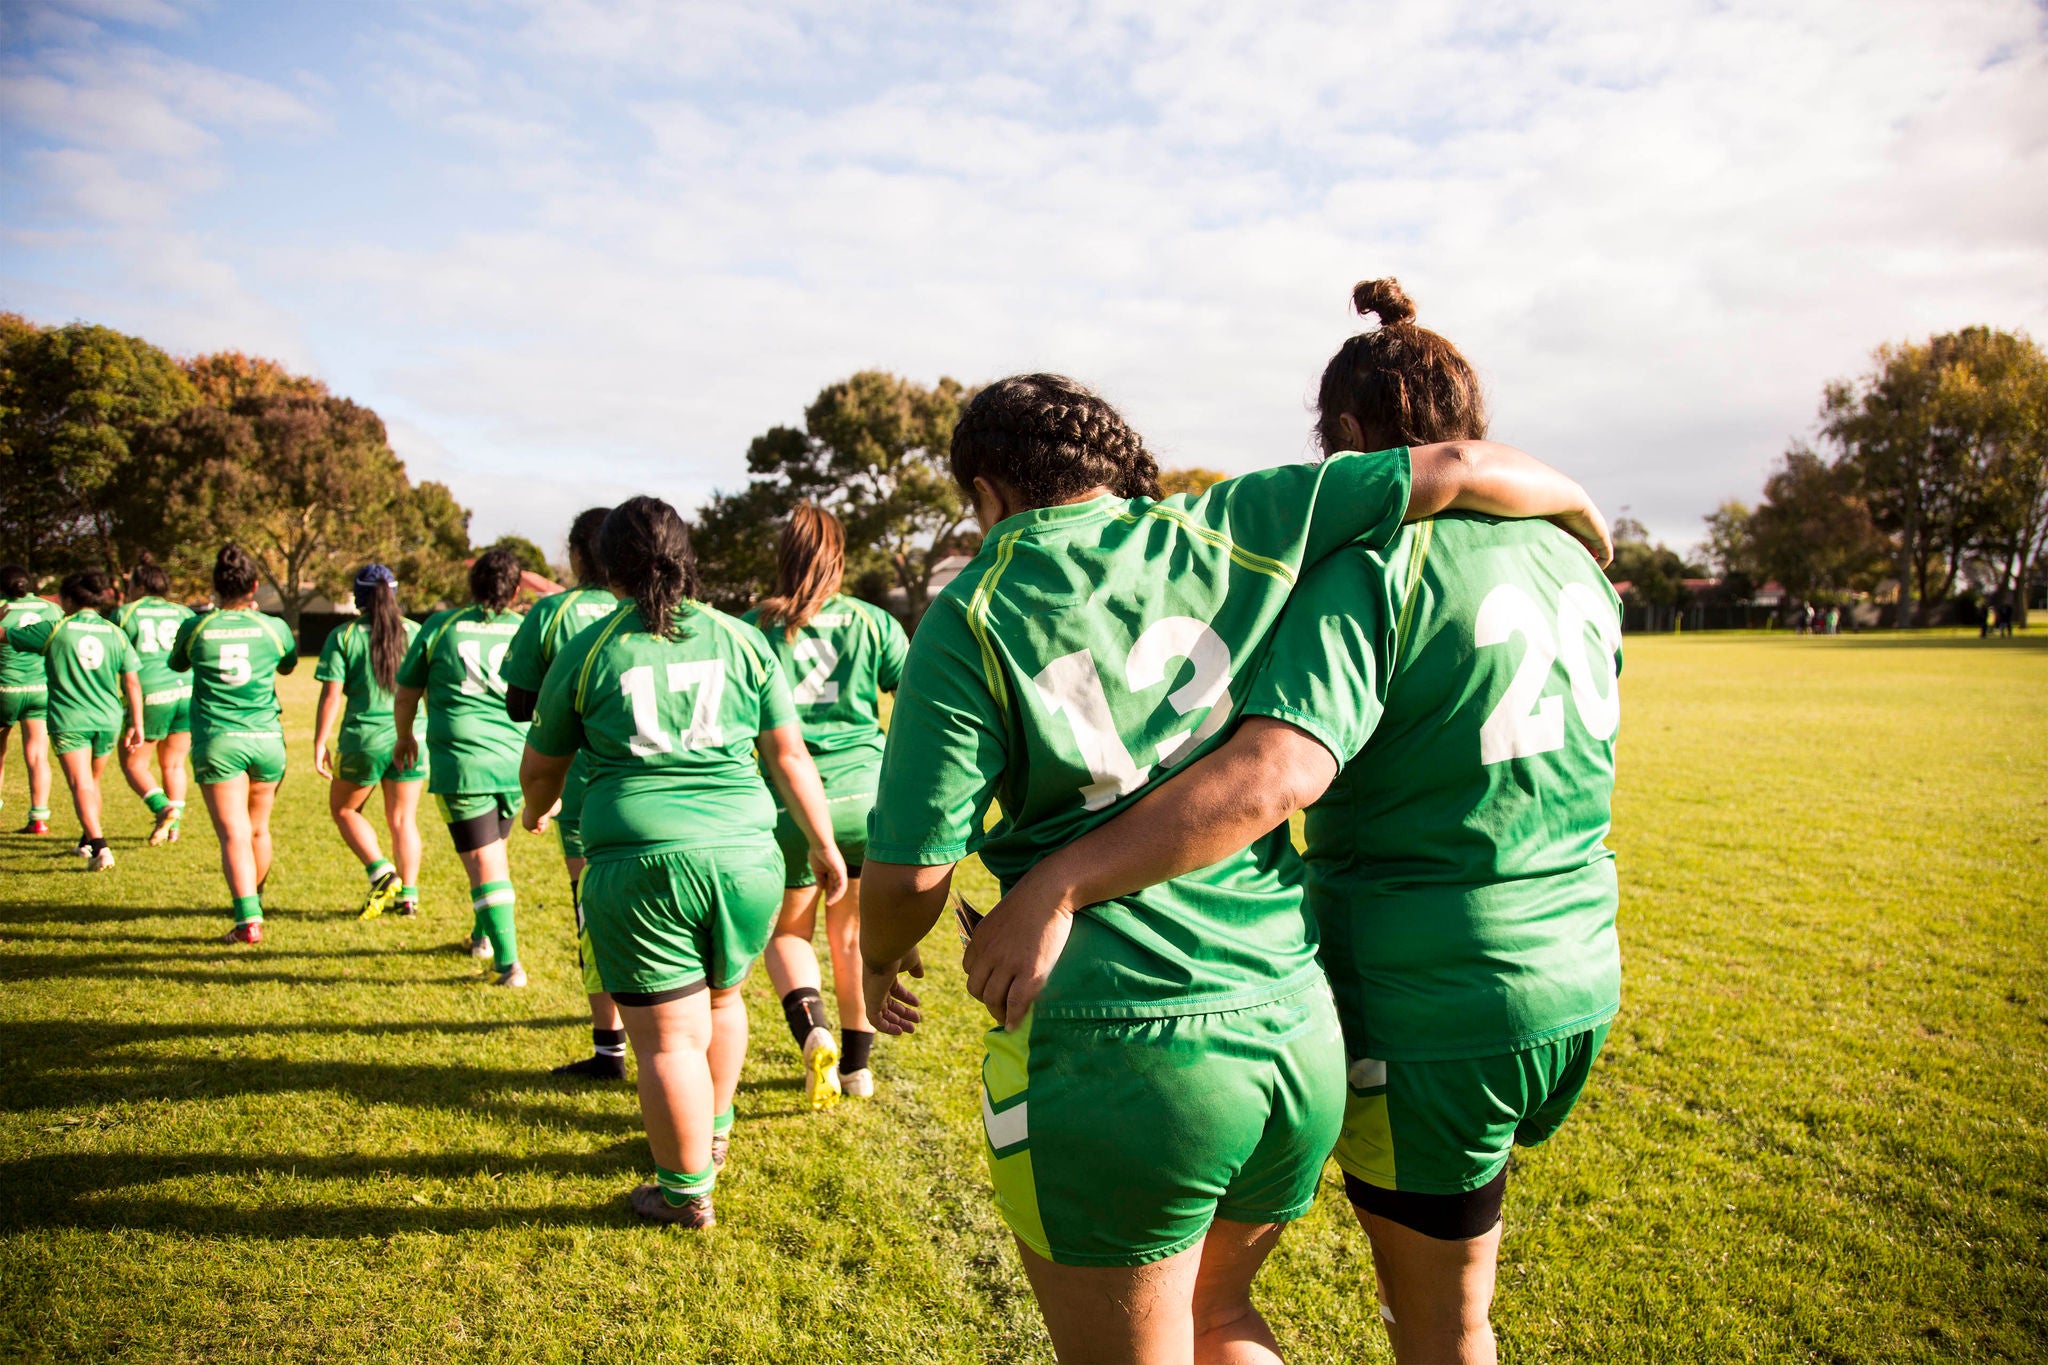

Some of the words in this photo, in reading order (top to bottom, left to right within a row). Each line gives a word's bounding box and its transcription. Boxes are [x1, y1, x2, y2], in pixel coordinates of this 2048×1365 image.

[78, 635, 104, 670] 9
[219, 643, 252, 687] 5
[793, 637, 839, 704] 2
[1474, 582, 1621, 766] 20
[620, 659, 725, 757] 17
[1033, 616, 1234, 811] 13
